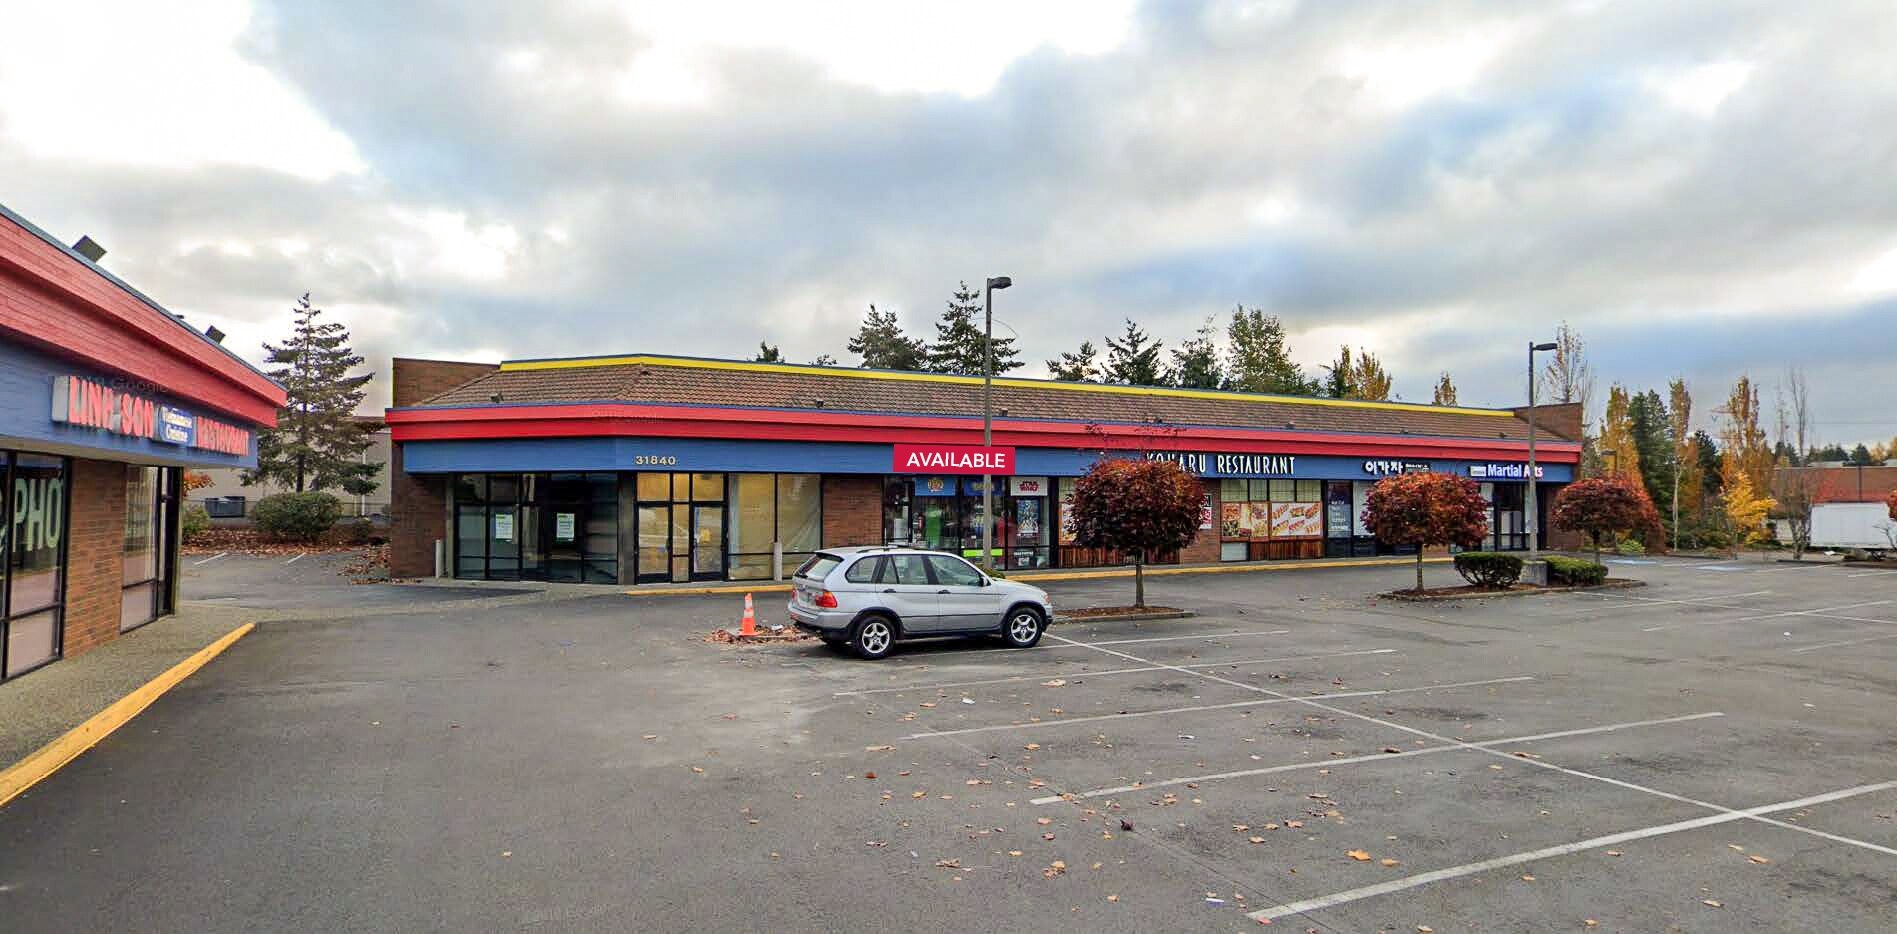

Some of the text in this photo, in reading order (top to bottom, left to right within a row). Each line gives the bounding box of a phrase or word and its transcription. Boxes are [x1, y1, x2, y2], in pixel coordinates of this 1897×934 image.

[635, 455, 676, 466] 31840
[1217, 455, 1296, 475] RESTAURANT
[1365, 461, 1404, 475] 이가자
[1488, 464, 1522, 478] Martial
[1523, 465, 1543, 478] Ats
